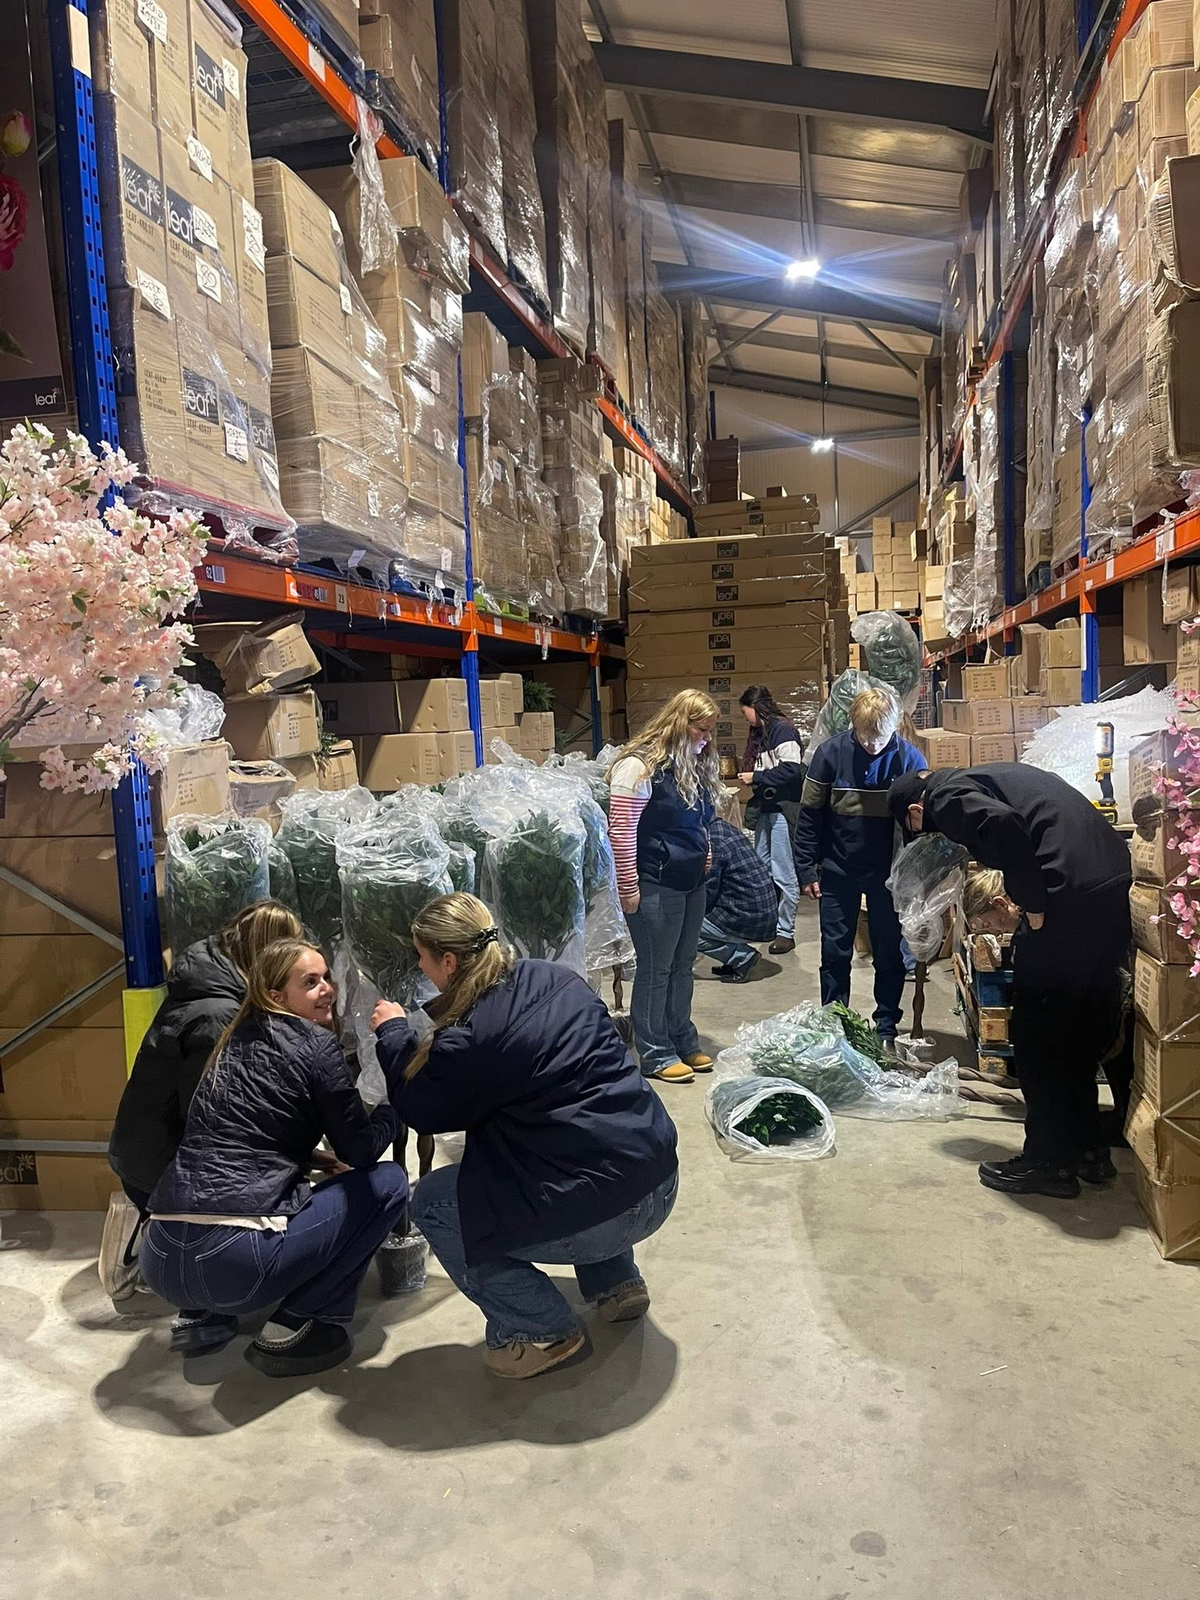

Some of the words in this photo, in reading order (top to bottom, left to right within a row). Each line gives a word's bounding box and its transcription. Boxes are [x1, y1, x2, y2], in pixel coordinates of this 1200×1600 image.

[122, 168, 154, 216] leaf
[167, 199, 194, 244] leaf
[34, 391, 57, 406] leaf
[717, 590, 734, 601] leaf
[714, 659, 731, 670] leaf
